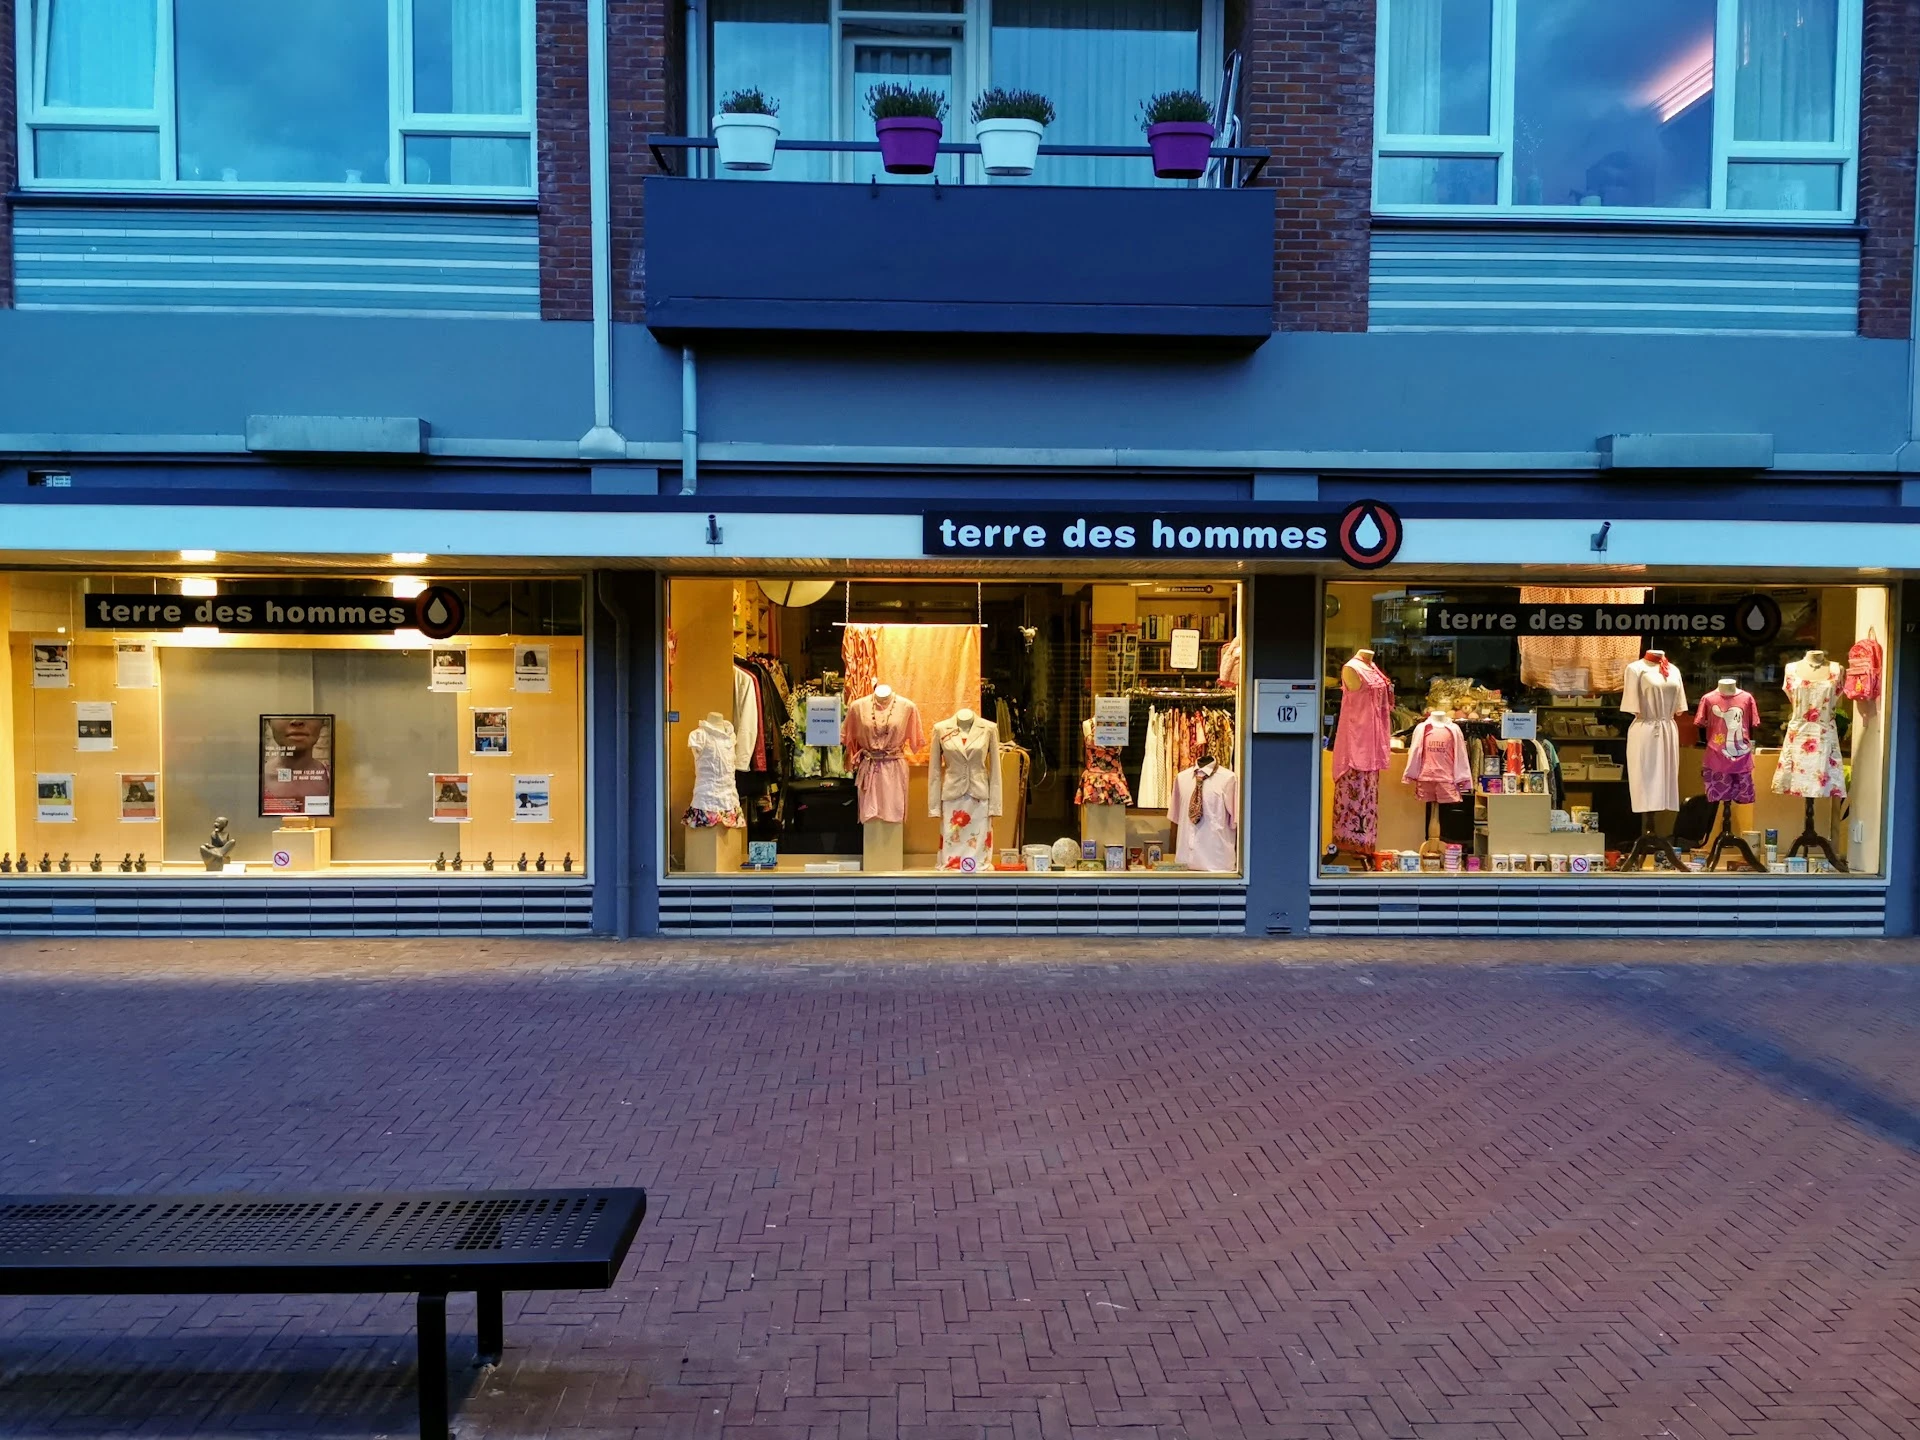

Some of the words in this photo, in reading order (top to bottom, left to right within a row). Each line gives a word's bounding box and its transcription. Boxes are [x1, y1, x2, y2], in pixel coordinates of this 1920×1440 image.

[939, 518, 1046, 548] terre
[1062, 518, 1136, 548] des
[1152, 518, 1327, 549] hommes
[97, 600, 182, 622] terre
[195, 600, 253, 622] des
[266, 601, 406, 624] hommes
[1438, 608, 1516, 630] terre
[1529, 608, 1583, 630] des
[1596, 608, 1725, 632] hommes
[1906, 623, 1916, 632] 17
[1281, 707, 1294, 721] 17
